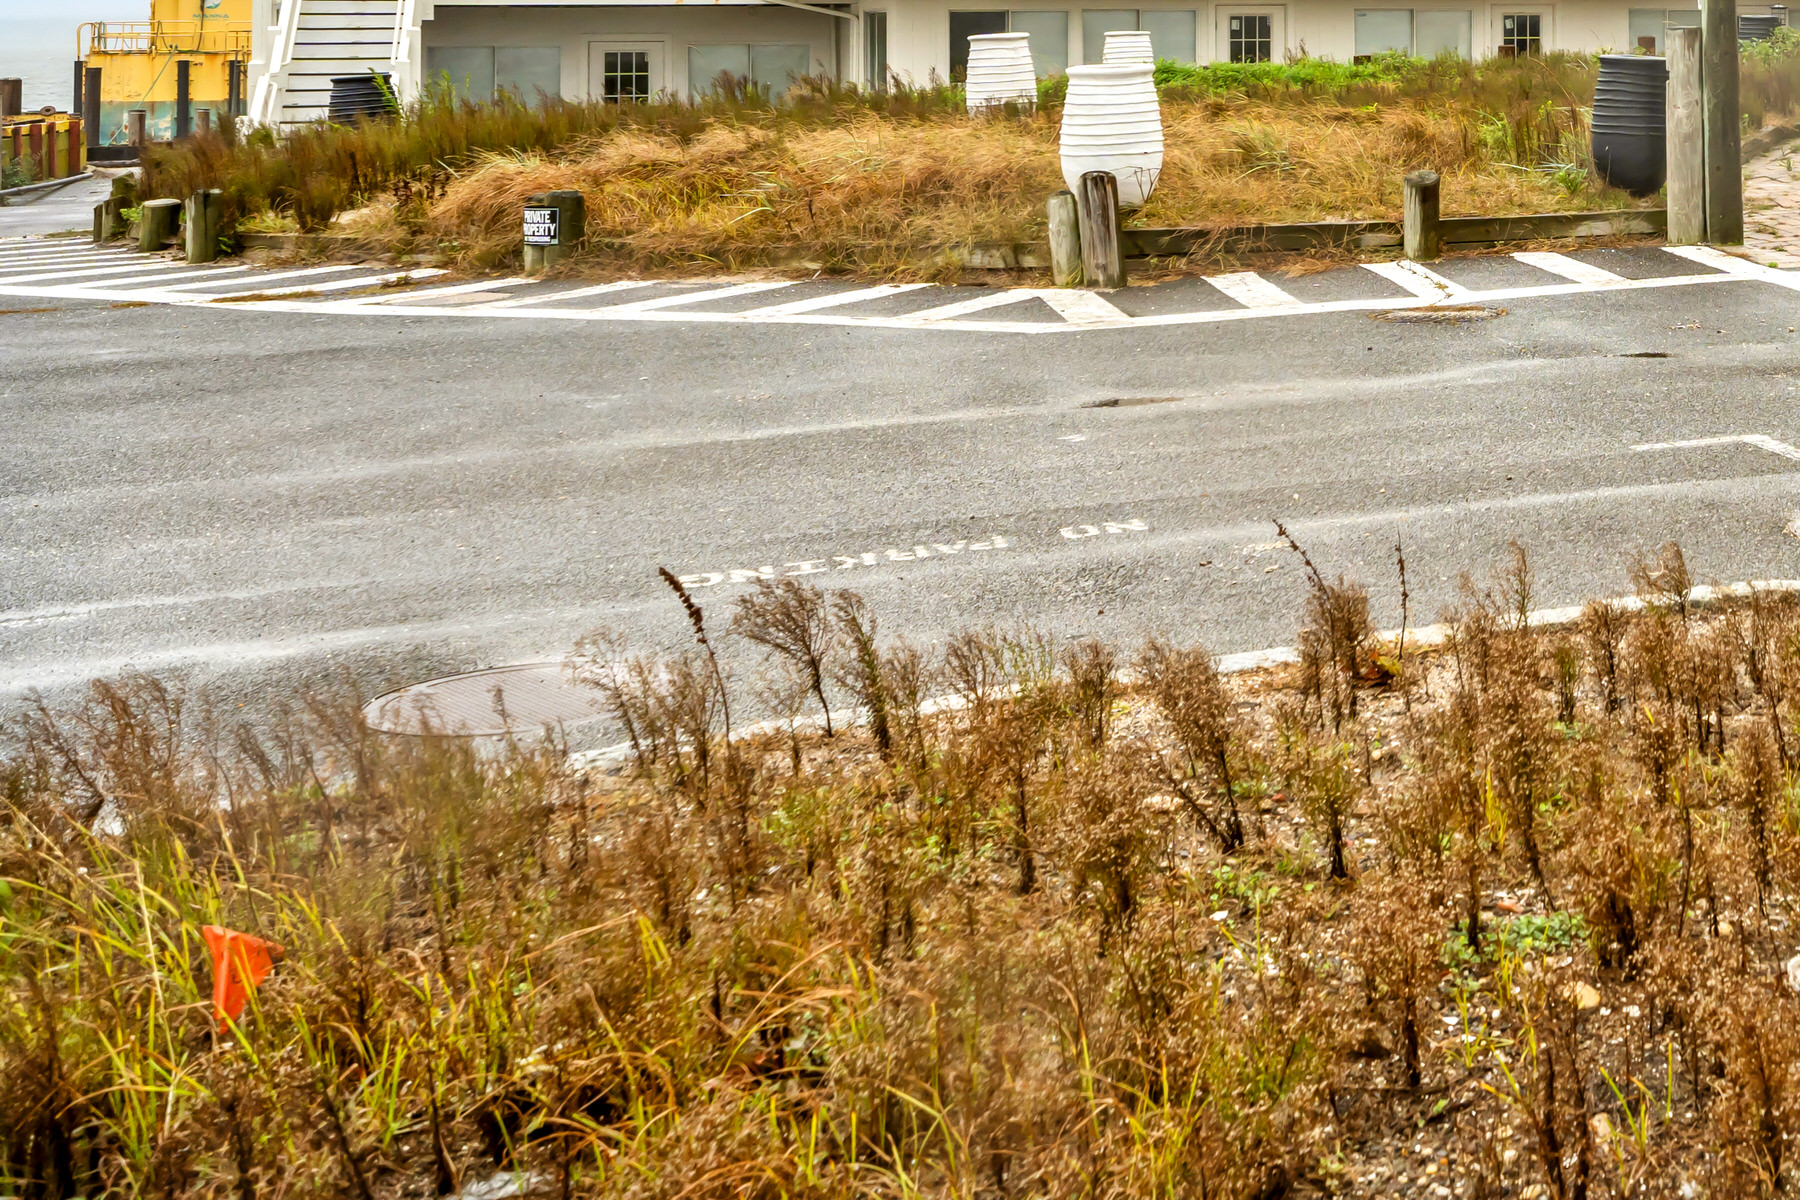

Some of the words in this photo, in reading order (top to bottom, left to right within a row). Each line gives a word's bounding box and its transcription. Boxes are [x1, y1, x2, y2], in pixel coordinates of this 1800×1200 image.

[524, 210, 551, 223] PRIVATE
[523, 223, 556, 235] ROPERTY
[1059, 518, 1150, 540] NO
[678, 534, 1010, 589] PARKING
